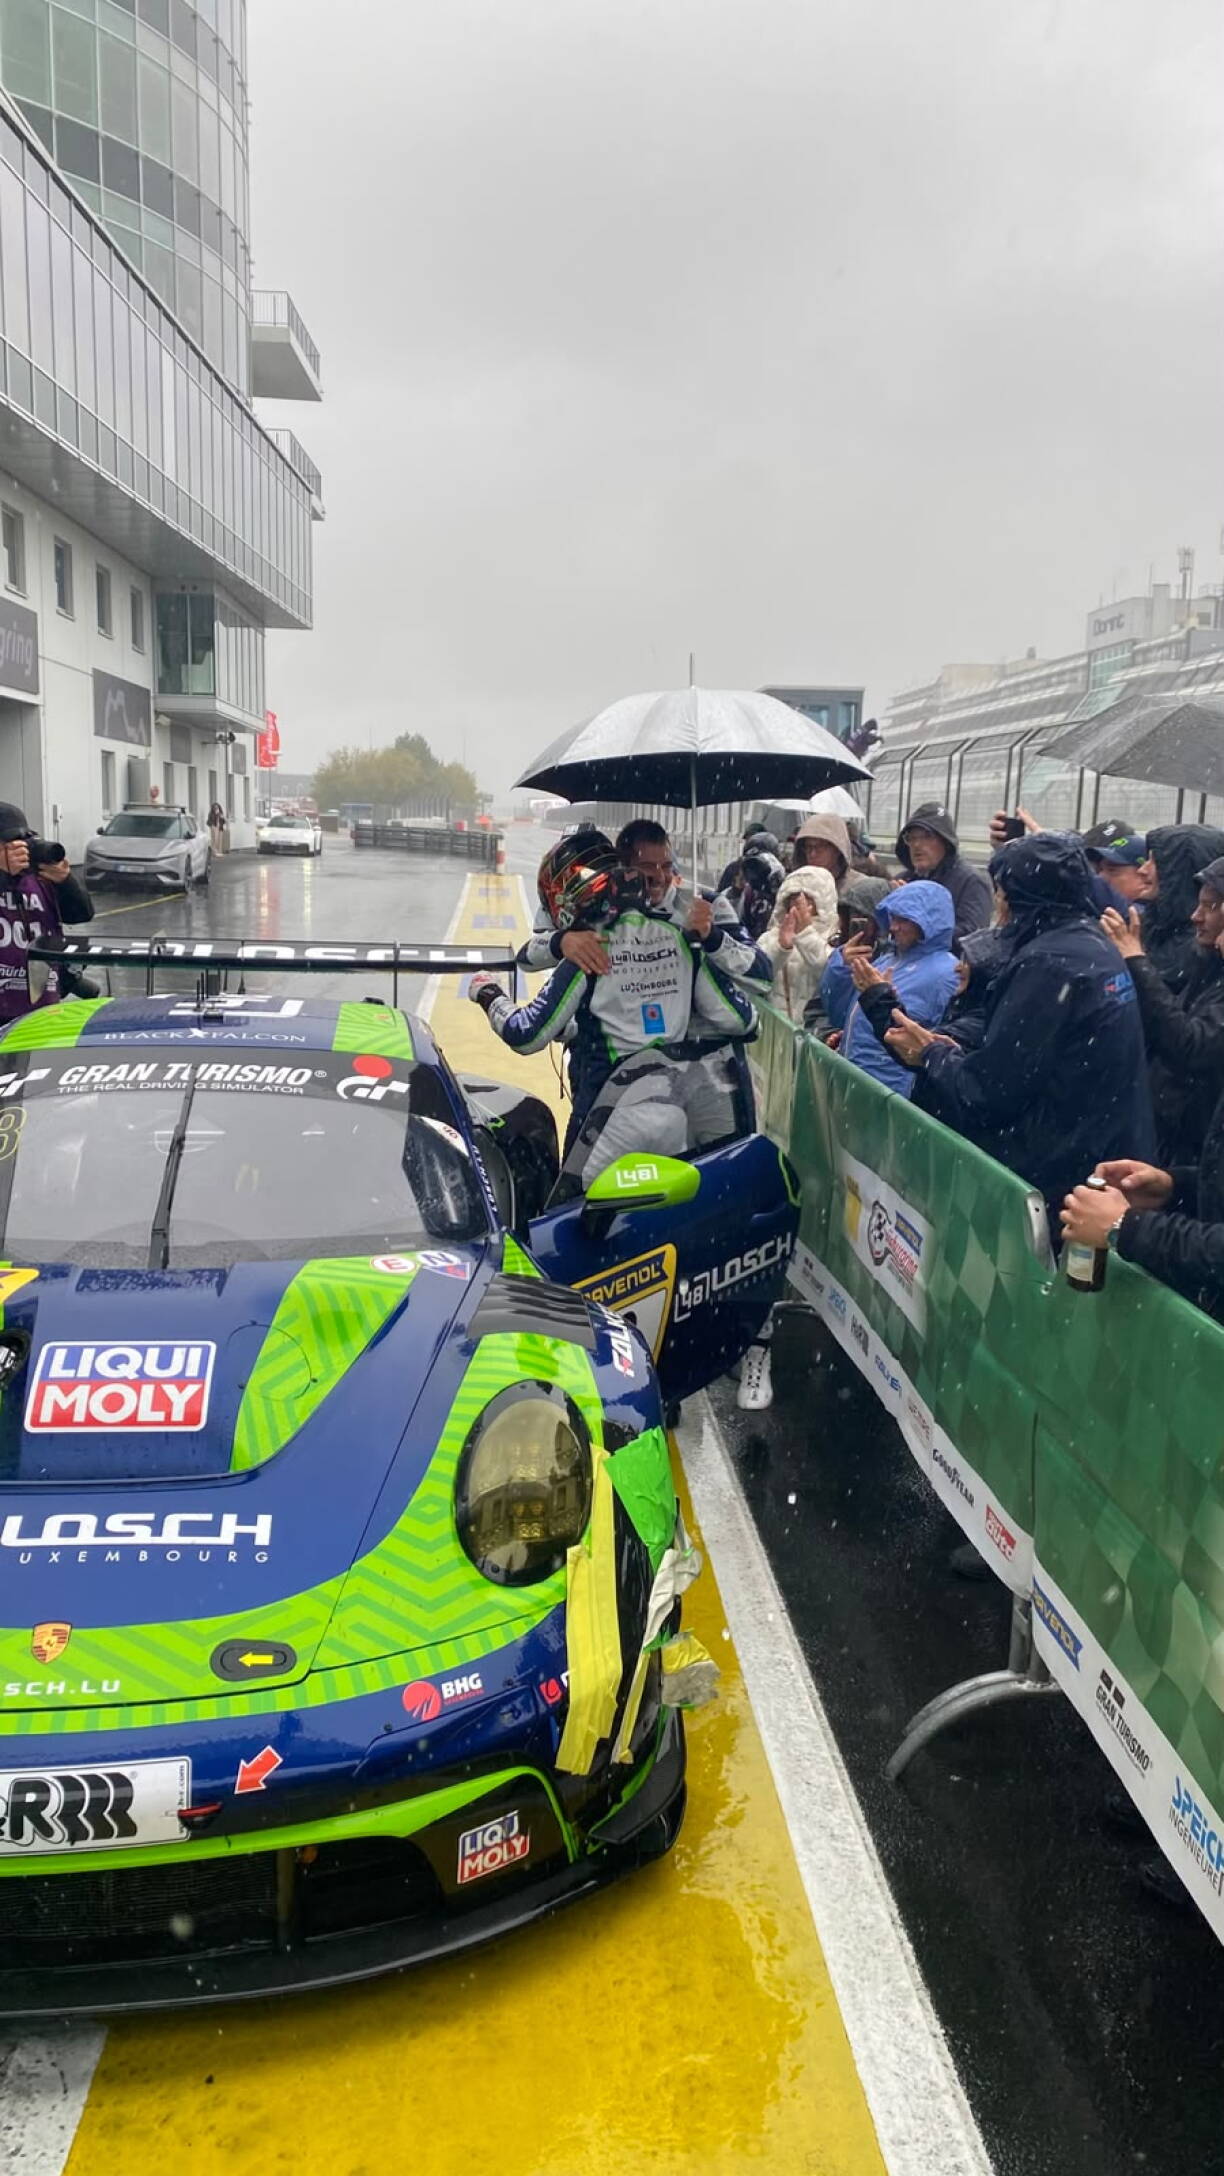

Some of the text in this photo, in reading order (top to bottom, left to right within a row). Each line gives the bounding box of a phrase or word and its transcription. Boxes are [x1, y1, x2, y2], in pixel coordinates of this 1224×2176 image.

[58, 1064, 158, 1085] GRAN
[58, 1086, 90, 1094] THE
[93, 1083, 134, 1091] REAL
[209, 1082, 304, 1095] SIMULATOR
[711, 1231, 791, 1292] LOSCH
[49, 1347, 203, 1379] LIQUI
[39, 1383, 202, 1423] MOLY
[1, 1513, 272, 1546] LOSCH
[3, 1680, 121, 1696] SCH.LU
[441, 1673, 482, 1699] BHG
[1096, 1684, 1117, 1721] GRAN
[1116, 1713, 1149, 1770] TURISMO
[464, 1814, 518, 1857] LIQU
[463, 1835, 526, 1878] MOLY
